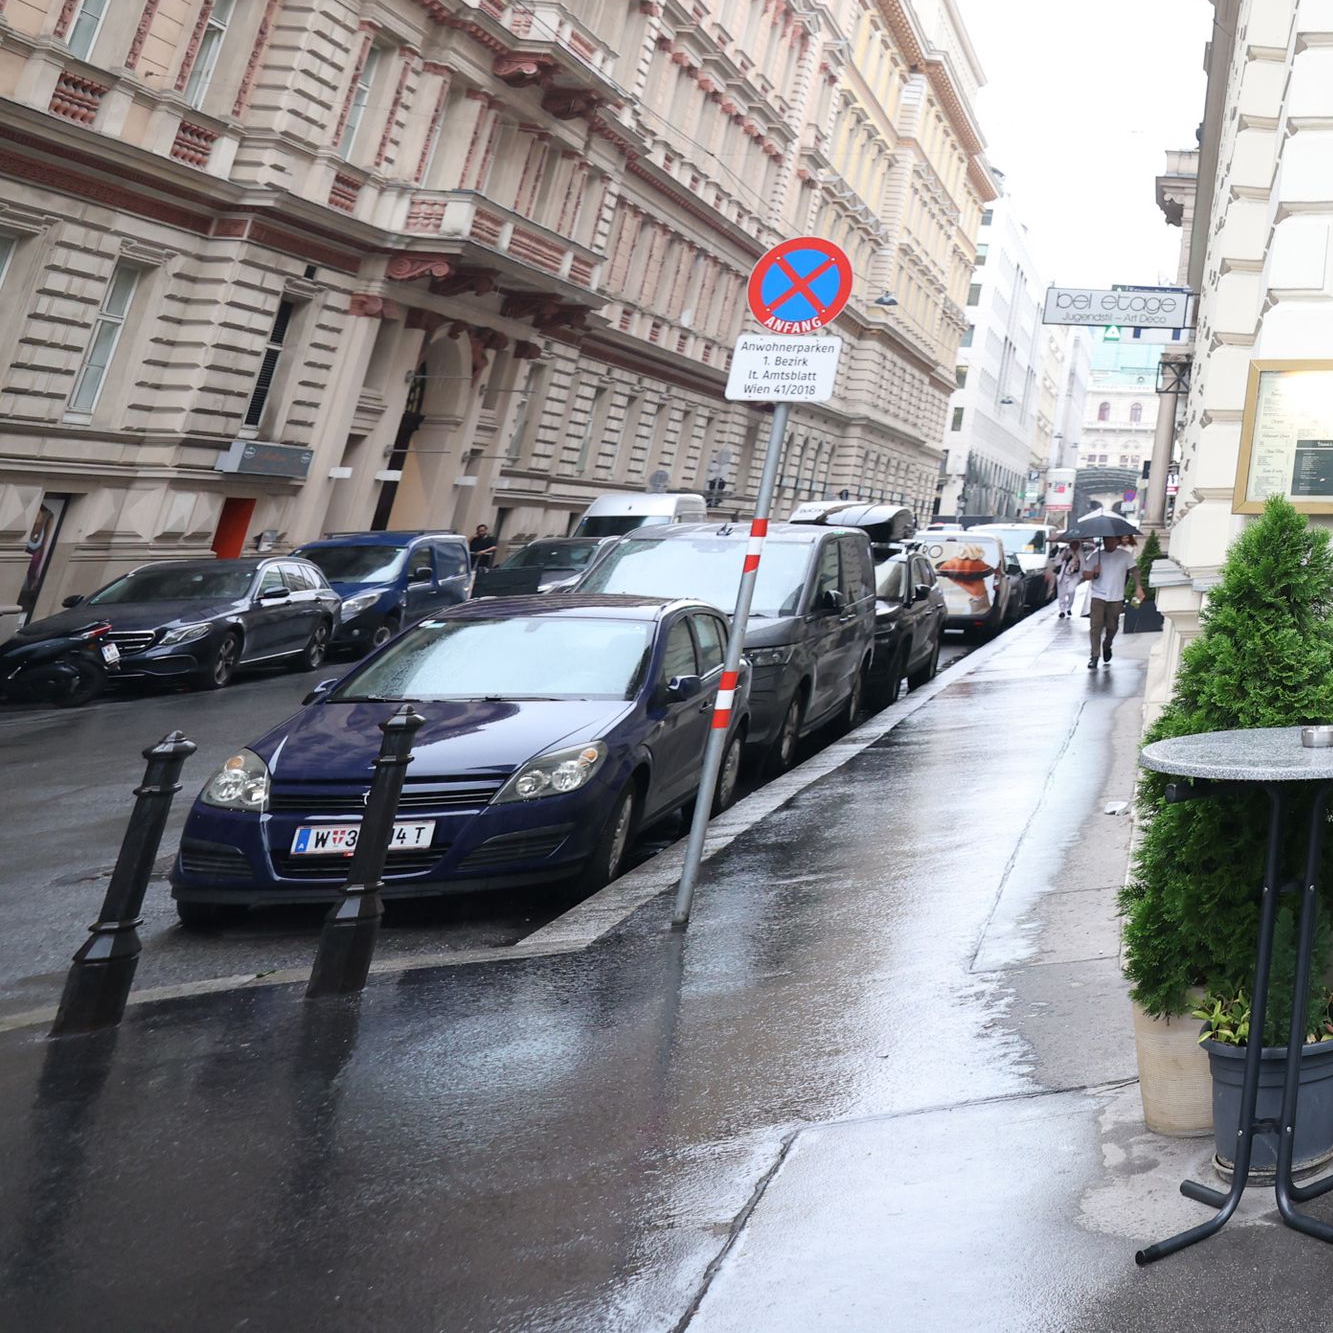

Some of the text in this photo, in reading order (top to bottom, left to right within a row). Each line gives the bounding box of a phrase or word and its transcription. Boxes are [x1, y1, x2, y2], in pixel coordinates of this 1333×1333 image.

[1056, 292, 1177, 315] bel etage
[1062, 312, 1112, 323] Jugendstil
[1124, 315, 1138, 323] Art
[1139, 315, 1167, 324] Deco
[763, 316, 822, 334] ANFANG
[741, 341, 835, 355] Anwohnerparken
[763, 356, 808, 367] 1. Bezirk
[762, 370, 817, 381] Amtsblatt
[744, 384, 816, 396] Wien 41/2018
